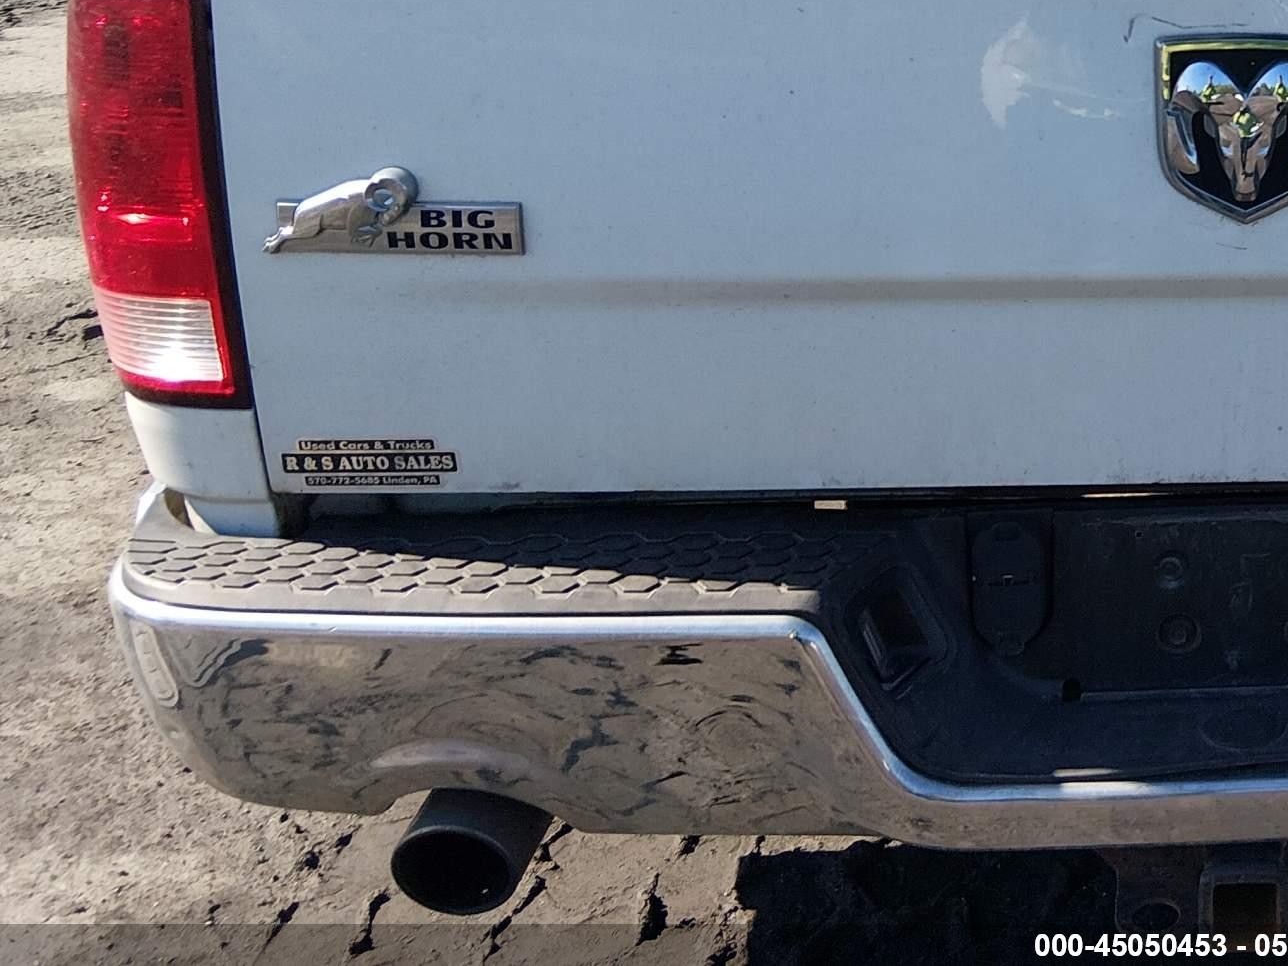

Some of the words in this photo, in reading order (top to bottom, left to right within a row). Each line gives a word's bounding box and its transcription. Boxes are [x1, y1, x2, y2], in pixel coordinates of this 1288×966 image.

[420, 209, 496, 229] BIG
[387, 231, 513, 250] HORN
[301, 440, 336, 451] Used
[339, 440, 370, 451] Cars
[374, 440, 384, 450] &
[388, 440, 433, 450] Trucks
[286, 456, 299, 471] R
[303, 456, 318, 471] &
[321, 456, 334, 471] S
[339, 455, 390, 471] AUTO
[394, 455, 454, 470] SALES
[424, 475, 439, 485] PA
